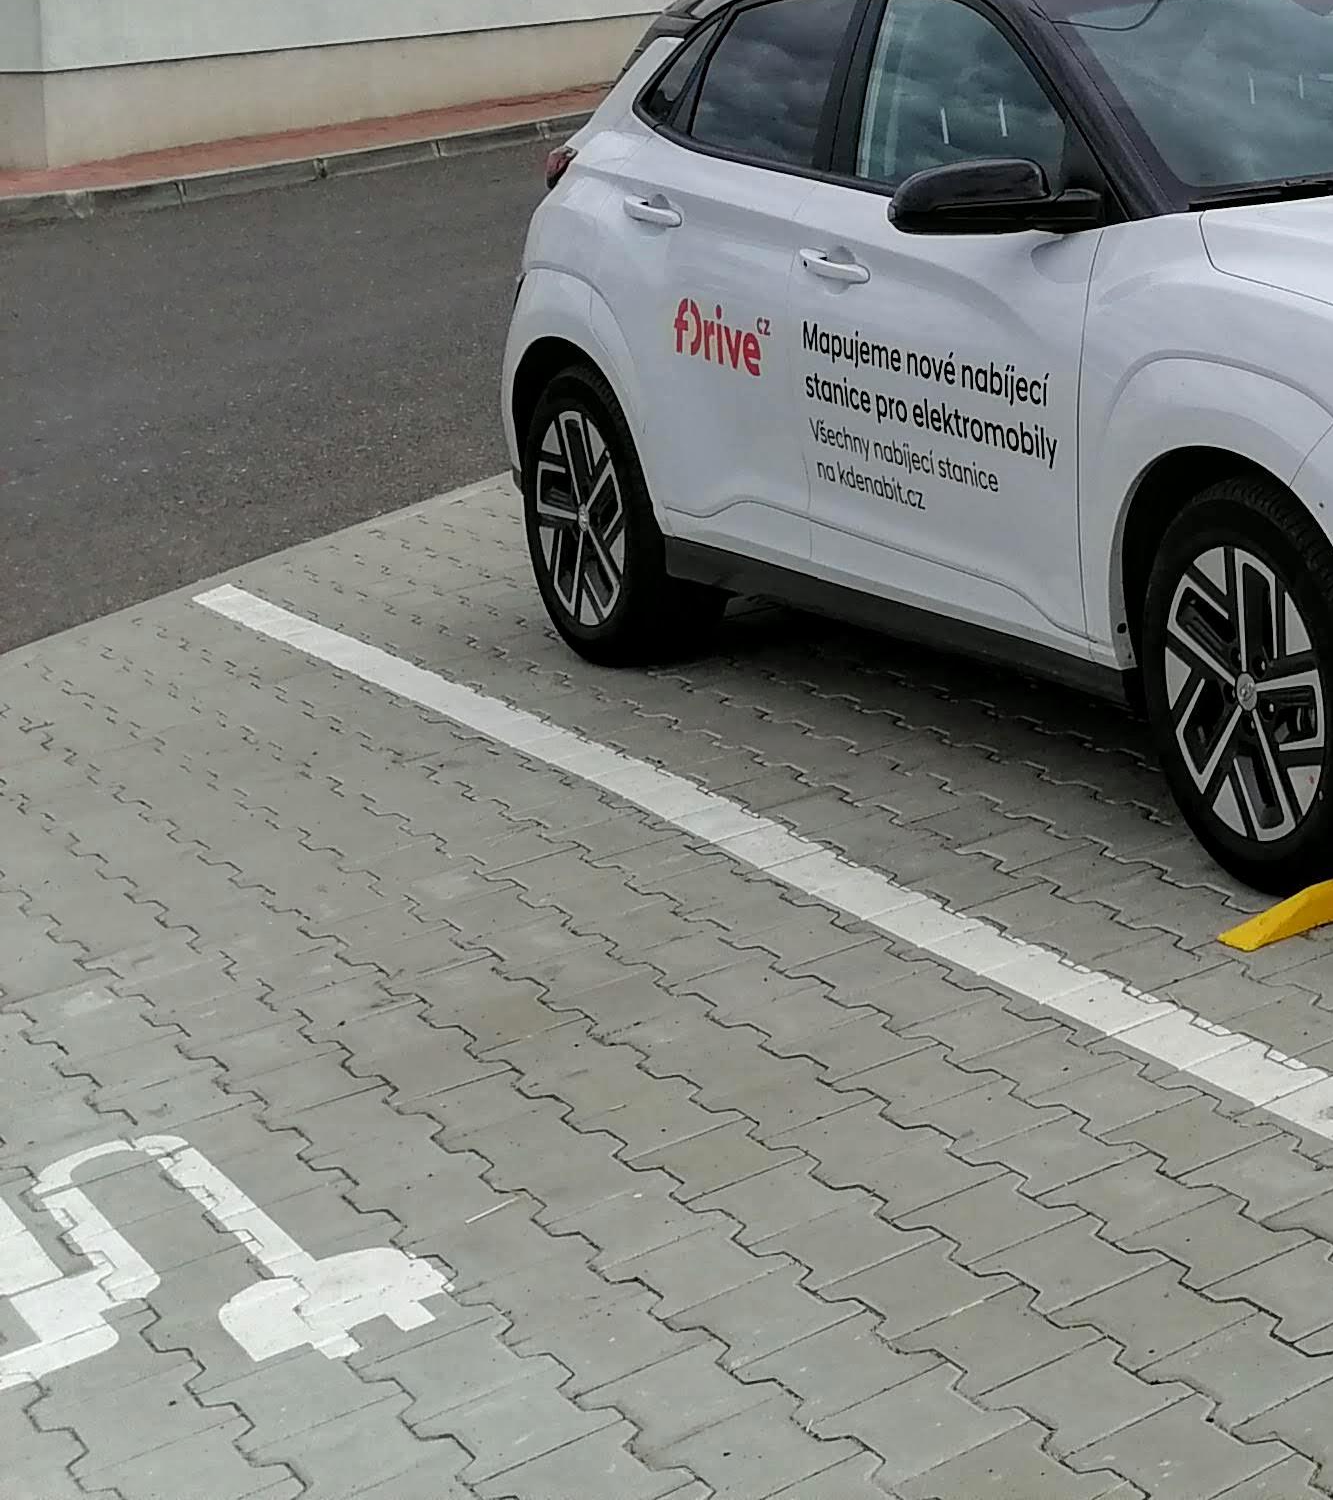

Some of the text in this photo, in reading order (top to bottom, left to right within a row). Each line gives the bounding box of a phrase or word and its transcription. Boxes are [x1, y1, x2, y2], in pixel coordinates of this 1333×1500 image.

[802, 320, 1049, 407] Mapujeme nové nabíjecí
[805, 374, 1057, 469] stanice pro elektromobily
[809, 418, 999, 493] Všechny nabíjecí stanice
[817, 461, 926, 511] na kdenabit.cz
